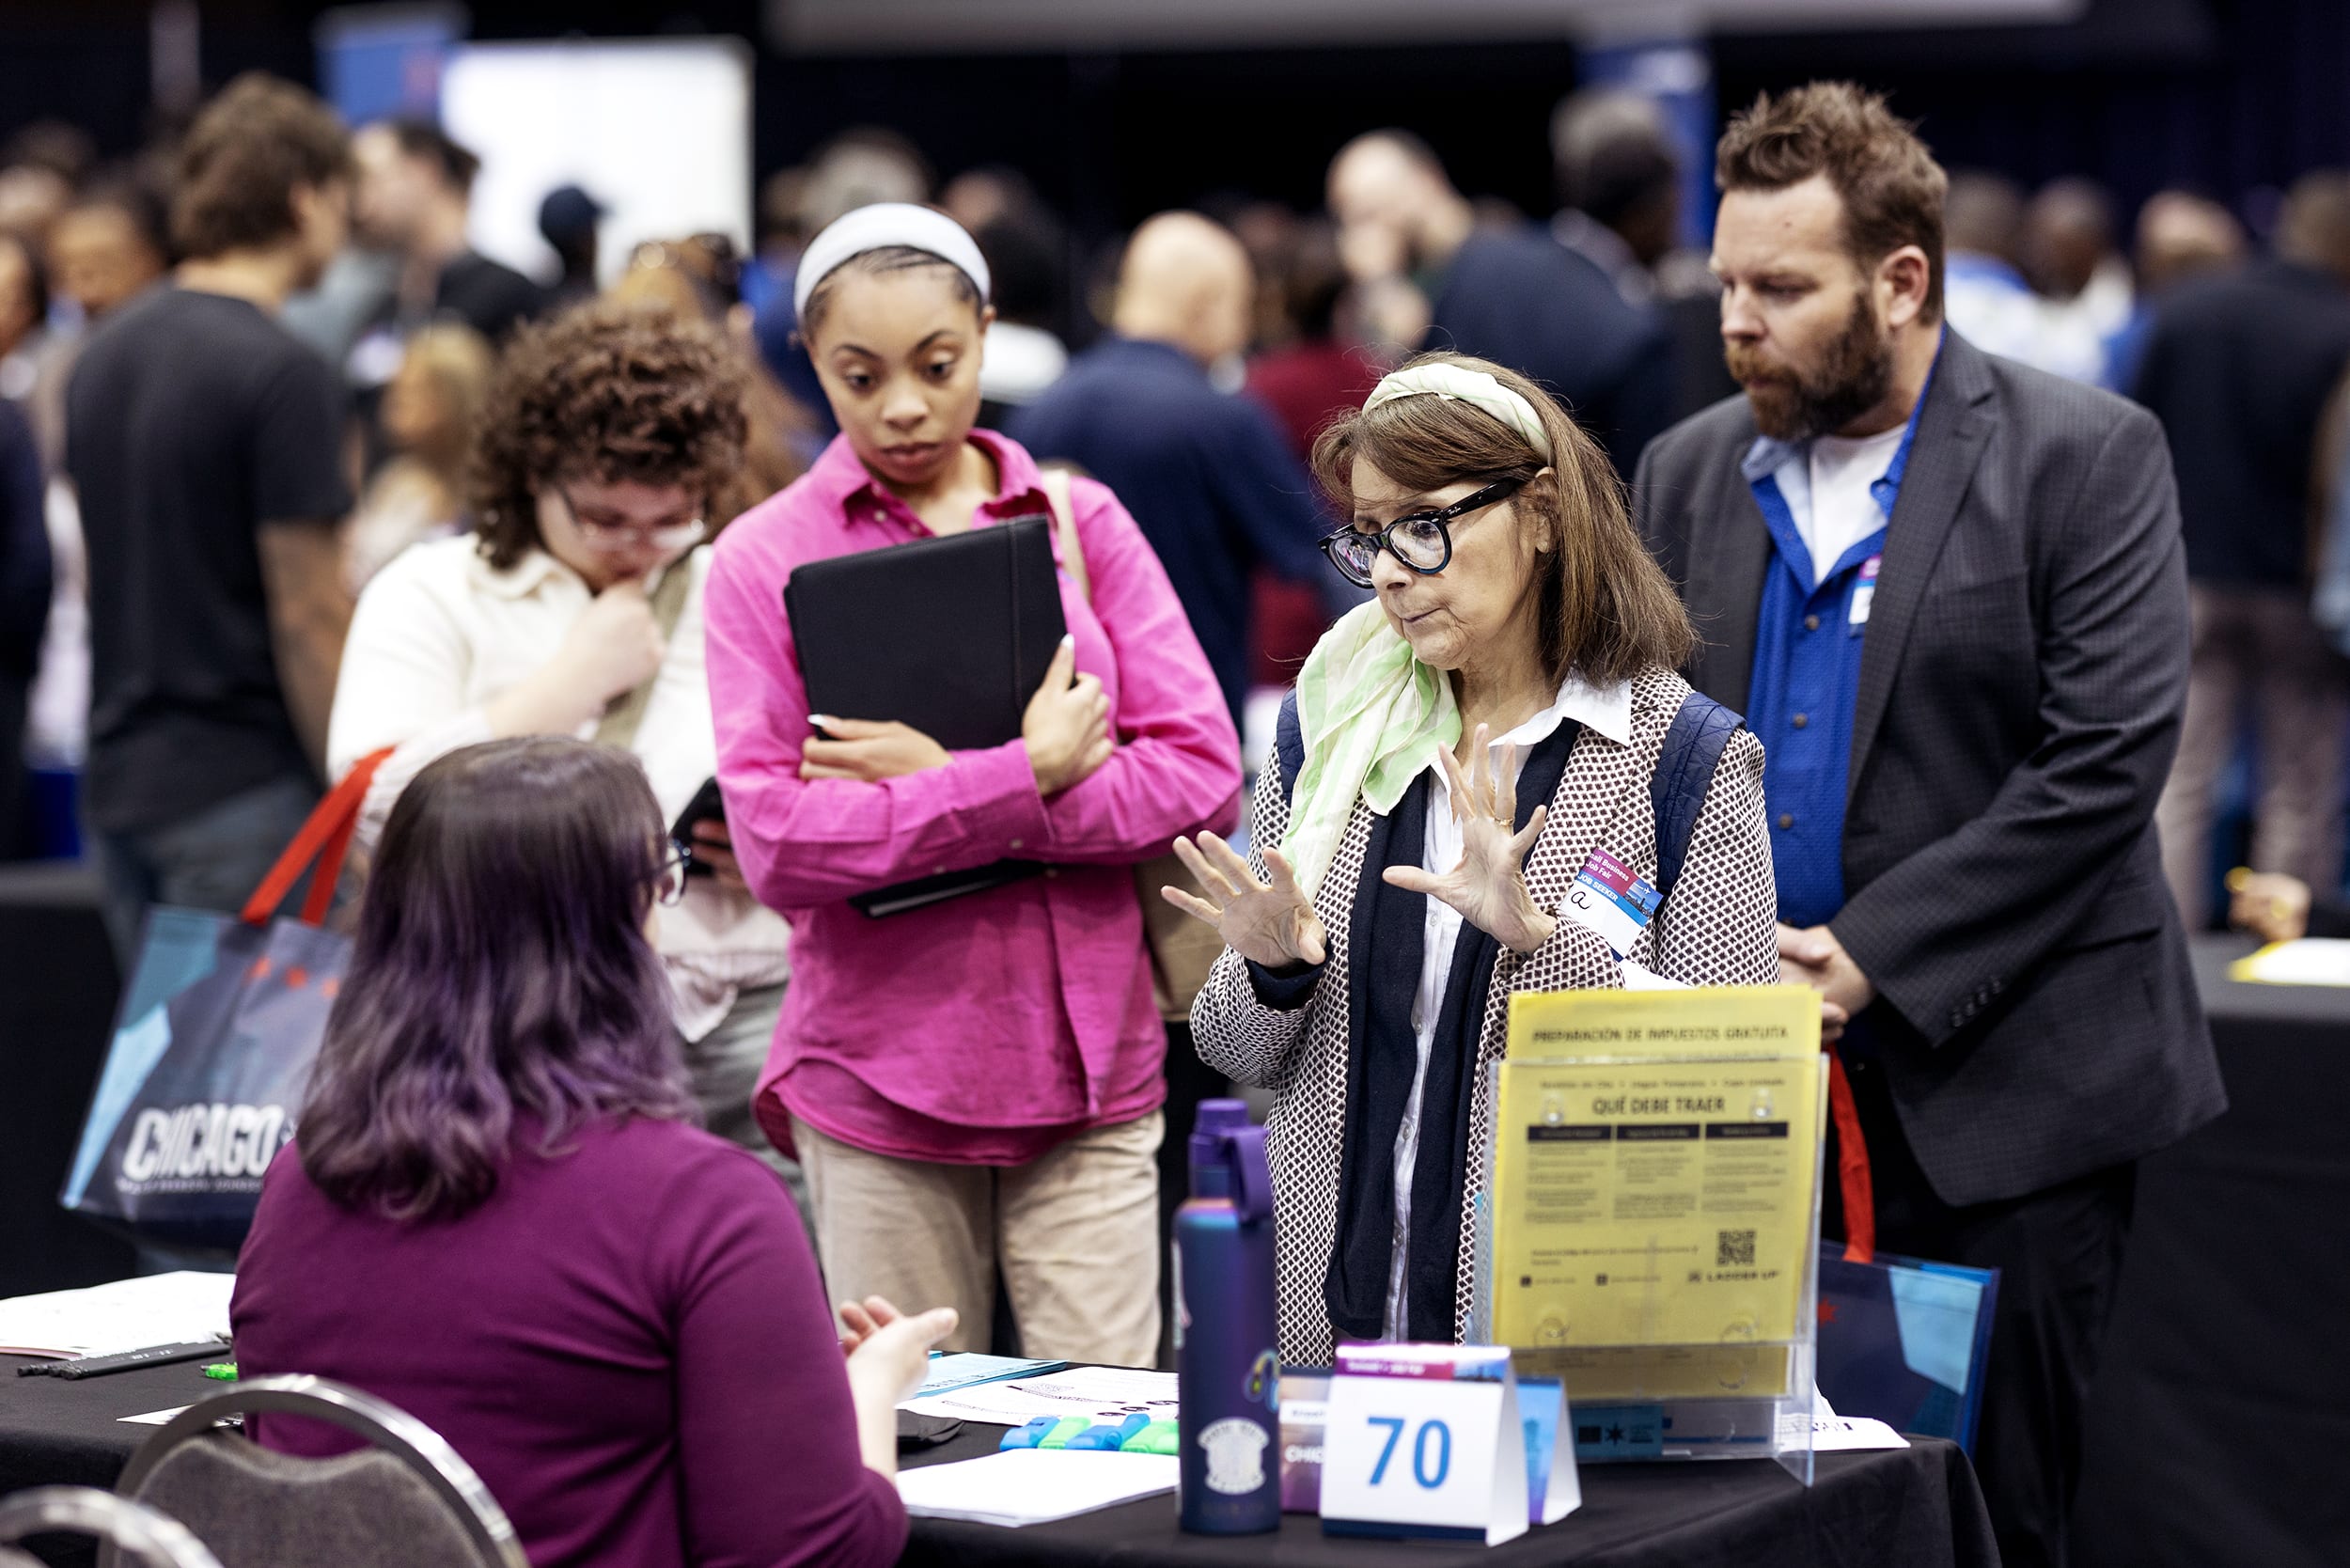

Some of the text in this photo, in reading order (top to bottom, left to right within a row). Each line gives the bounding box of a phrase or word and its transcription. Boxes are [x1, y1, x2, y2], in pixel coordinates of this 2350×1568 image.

[1586, 861, 1613, 880] Job Fair
[1602, 859, 1629, 881] Business
[1577, 873, 1618, 902] JOB SEEKER
[1627, 1028, 1642, 1040] DE
[1592, 1094, 1726, 1115] QUÉ DEBE TRAER
[124, 1102, 284, 1181] CHICAGO
[1368, 1417, 1451, 1489] 70
